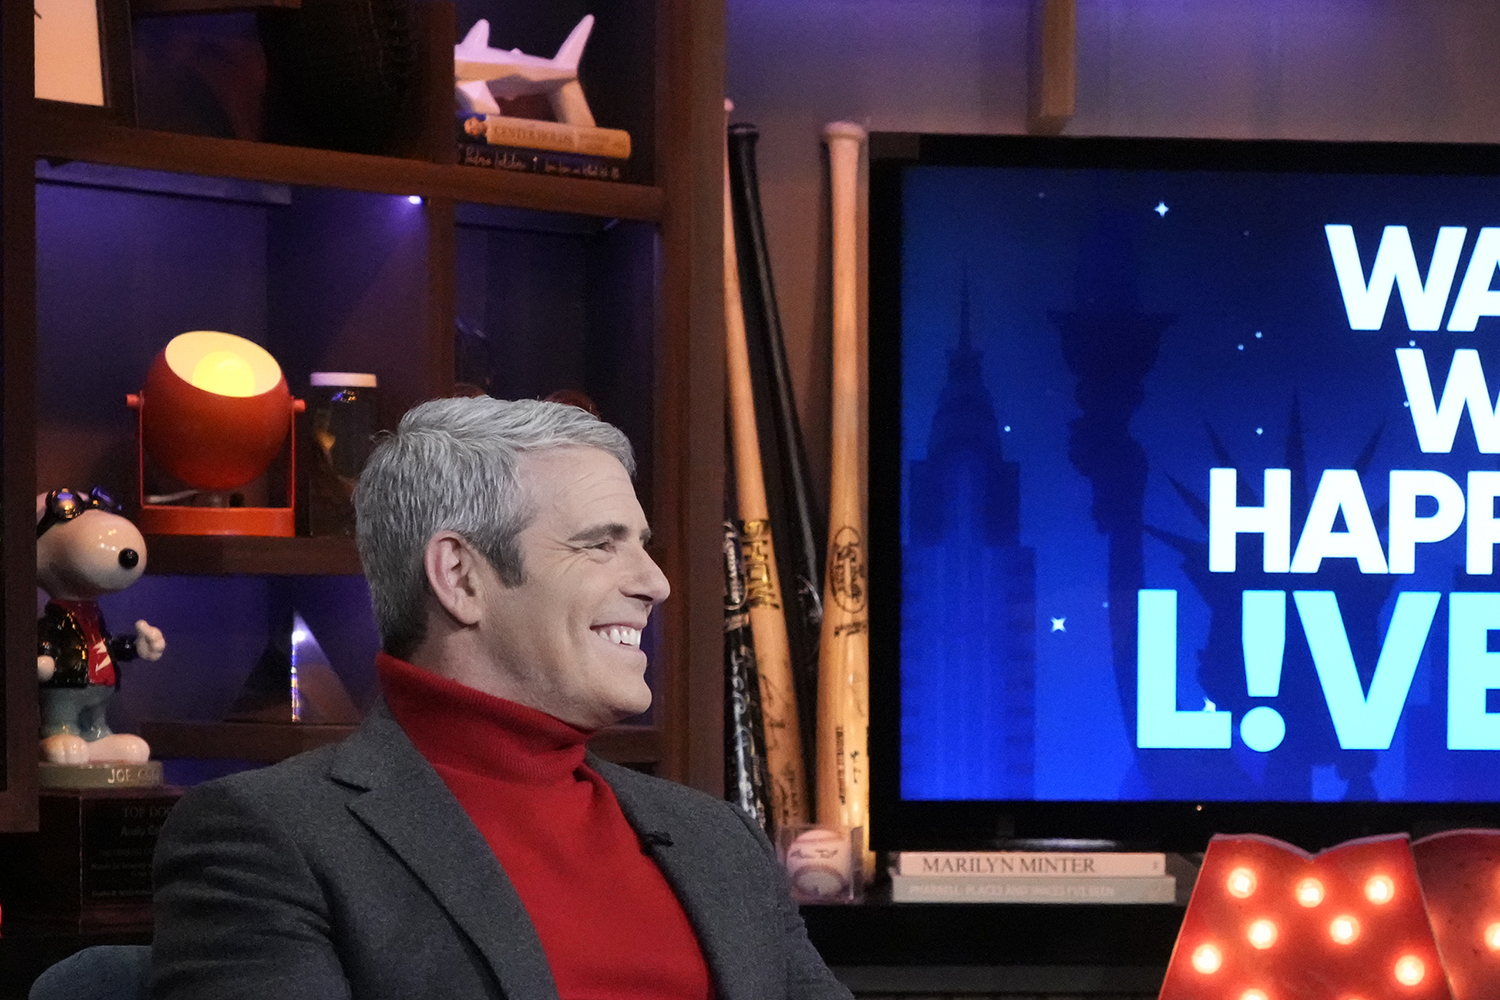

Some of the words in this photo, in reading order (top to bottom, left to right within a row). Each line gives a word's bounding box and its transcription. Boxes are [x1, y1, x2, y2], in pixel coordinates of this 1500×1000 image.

[107, 768, 134, 784] JOE
[922, 857, 1014, 874] MARILYN
[1019, 857, 1095, 874] MINTER
